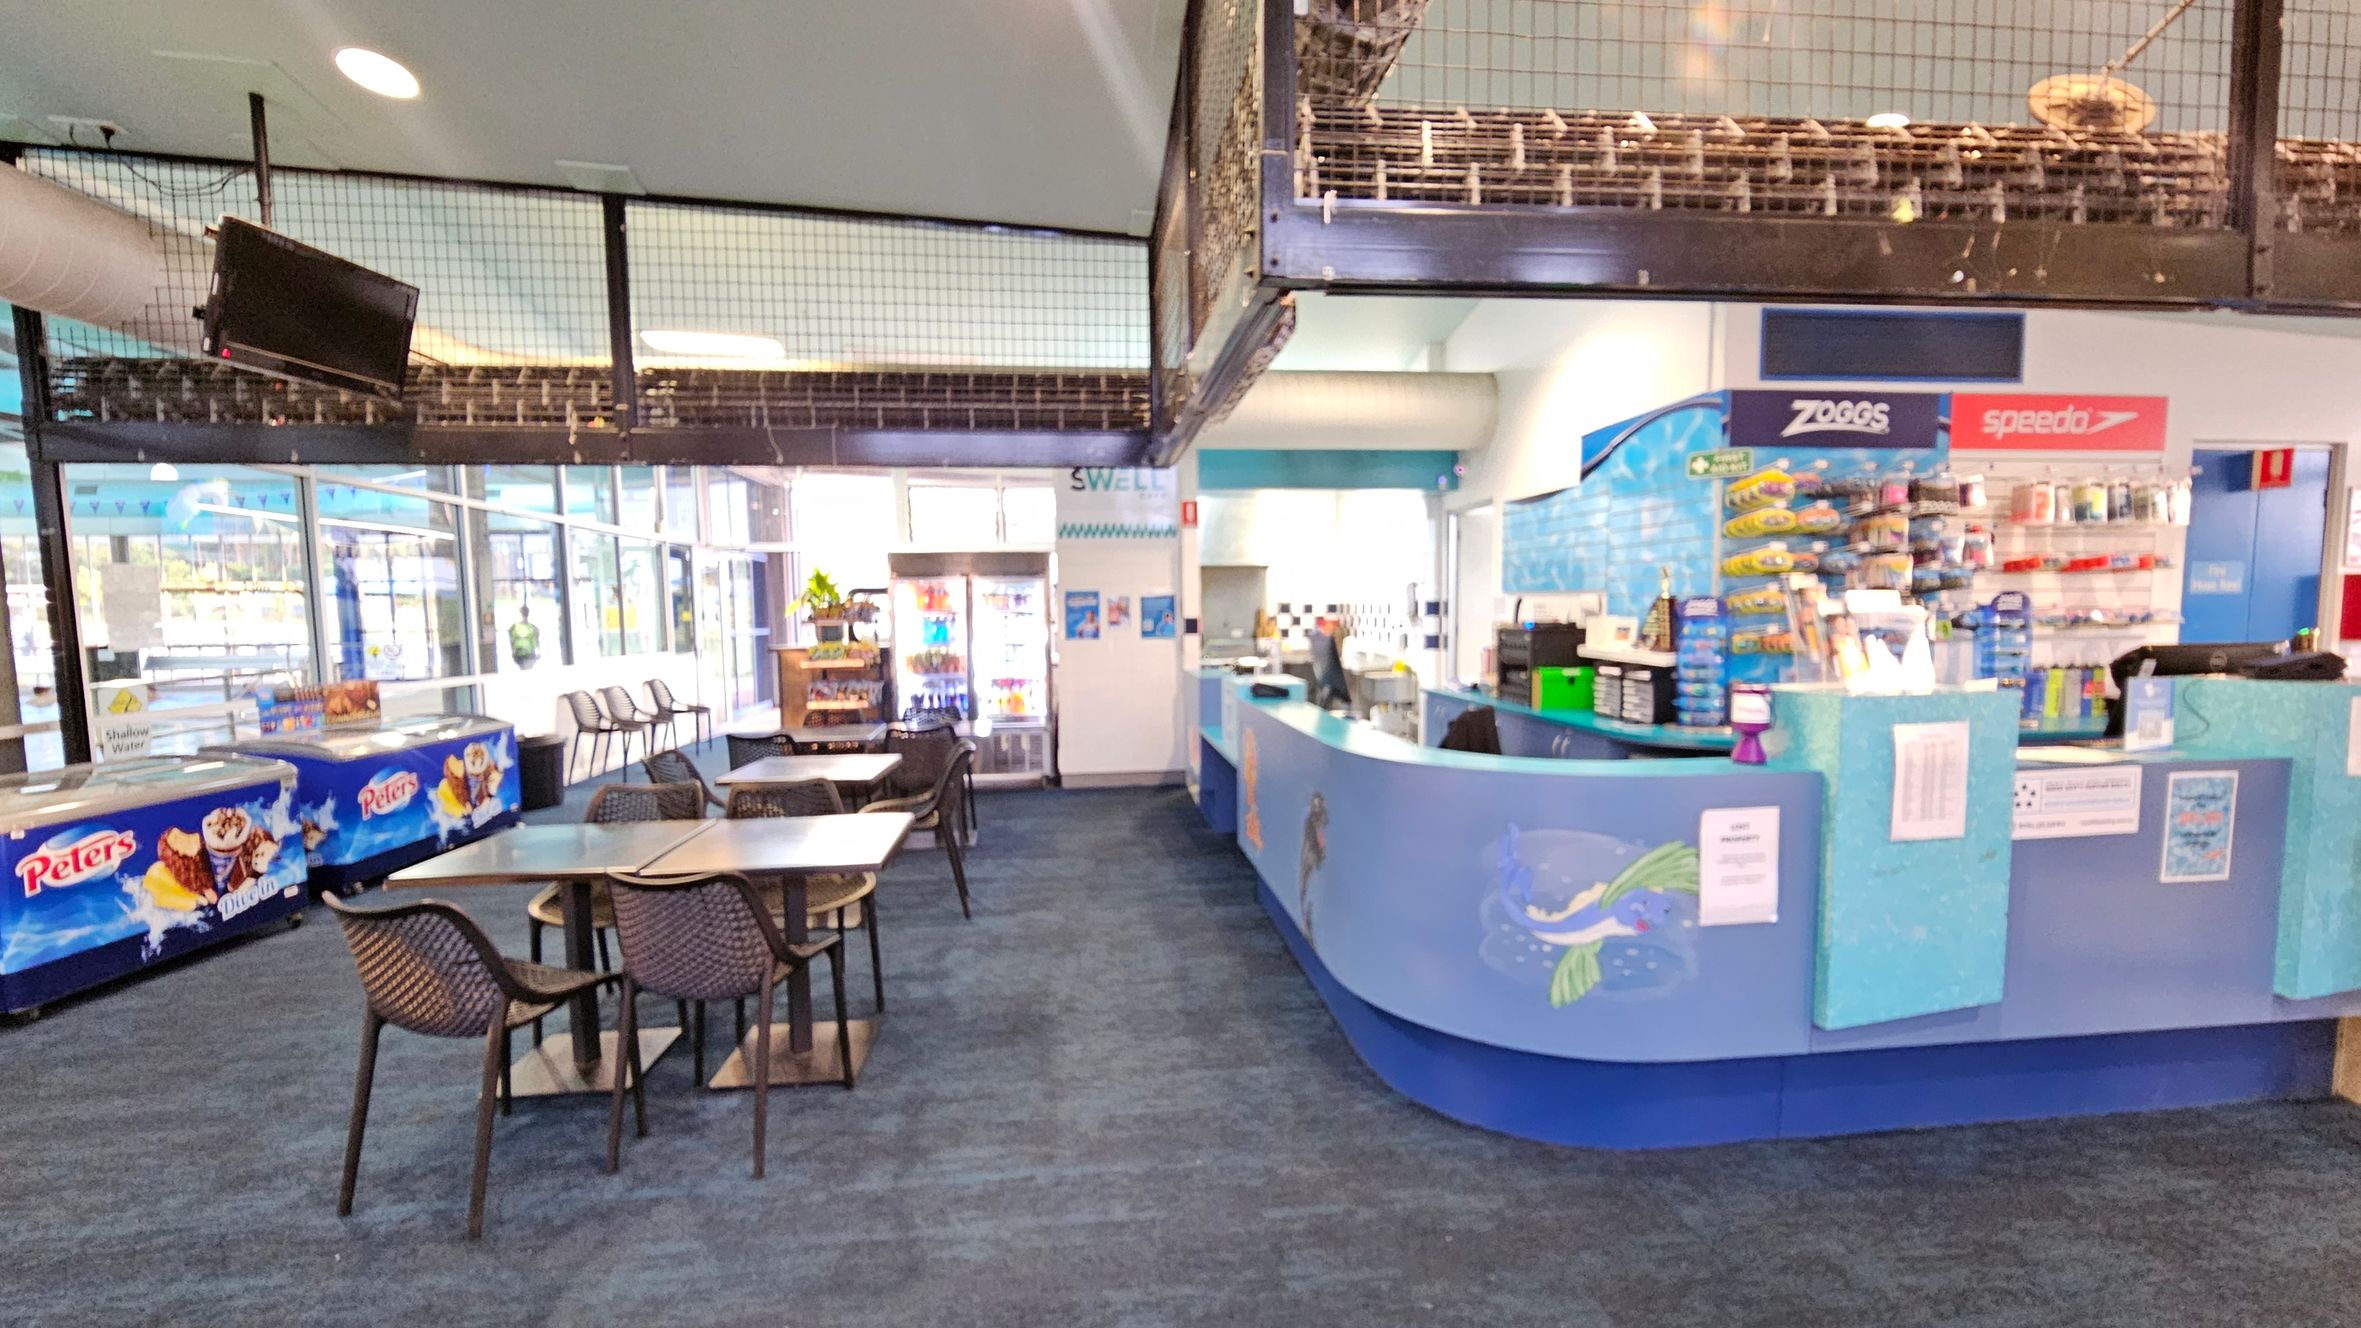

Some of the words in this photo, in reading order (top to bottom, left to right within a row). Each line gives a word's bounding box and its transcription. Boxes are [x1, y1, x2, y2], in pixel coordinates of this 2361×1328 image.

[1780, 400, 1891, 438] ZOGGS
[1983, 404, 2090, 440] speedo
[106, 725, 150, 741] Shallow
[112, 741, 144, 754] Water
[359, 774, 418, 819] Peters
[18, 831, 135, 896] Peters
